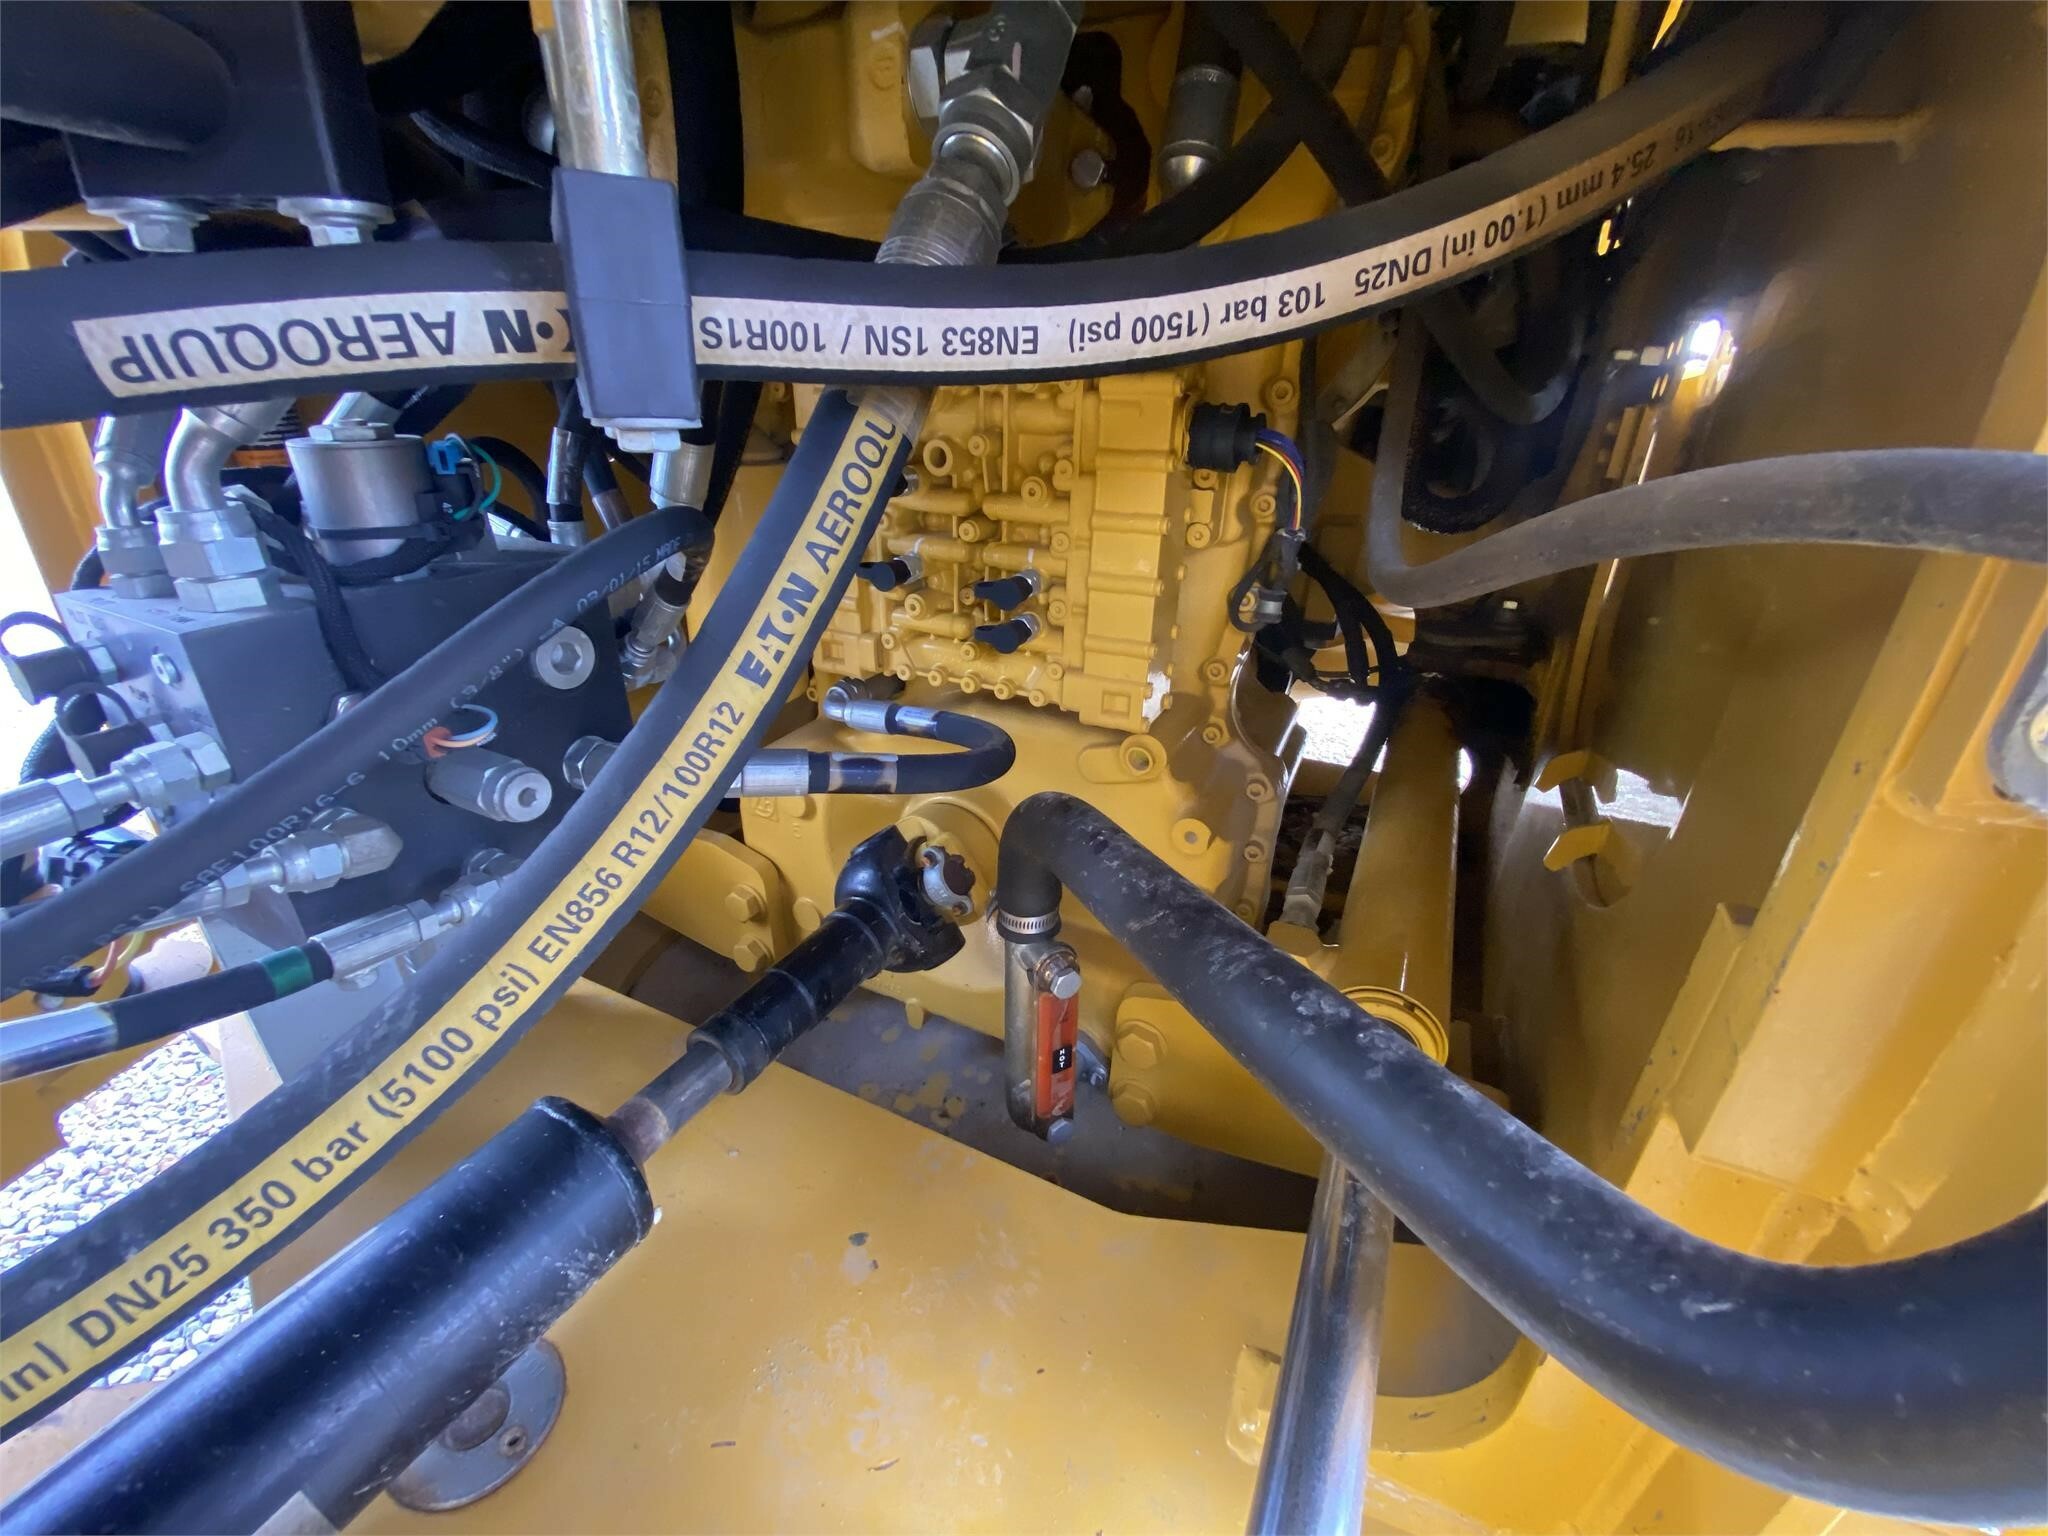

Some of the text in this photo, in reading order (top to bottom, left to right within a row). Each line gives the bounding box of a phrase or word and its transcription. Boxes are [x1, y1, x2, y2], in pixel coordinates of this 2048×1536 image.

[1611, 142, 1657, 188] 25.4
[1556, 171, 1604, 210] mm
[1484, 195, 1546, 249] (1.00
[1442, 228, 1475, 268] in)
[1354, 246, 1433, 297] DN25
[1220, 295, 1267, 325] bar
[1278, 282, 1327, 317] 103
[700, 316, 827, 351] 100R1S
[864, 324, 929, 356] 1SN
[942, 325, 1039, 355] EN853
[1069, 311, 1121, 354] psi)
[1131, 302, 1211, 345] (1500
[110, 311, 456, 384] AEROQUIP
[68, 1242, 210, 1350] DN25
[207, 1180, 297, 1250] 350
[291, 1121, 369, 1184] bar
[367, 1027, 474, 1119] (5100
[472, 962, 540, 1033] psi)
[527, 867, 623, 963] EN856
[610, 701, 745, 869] R12/100R12
